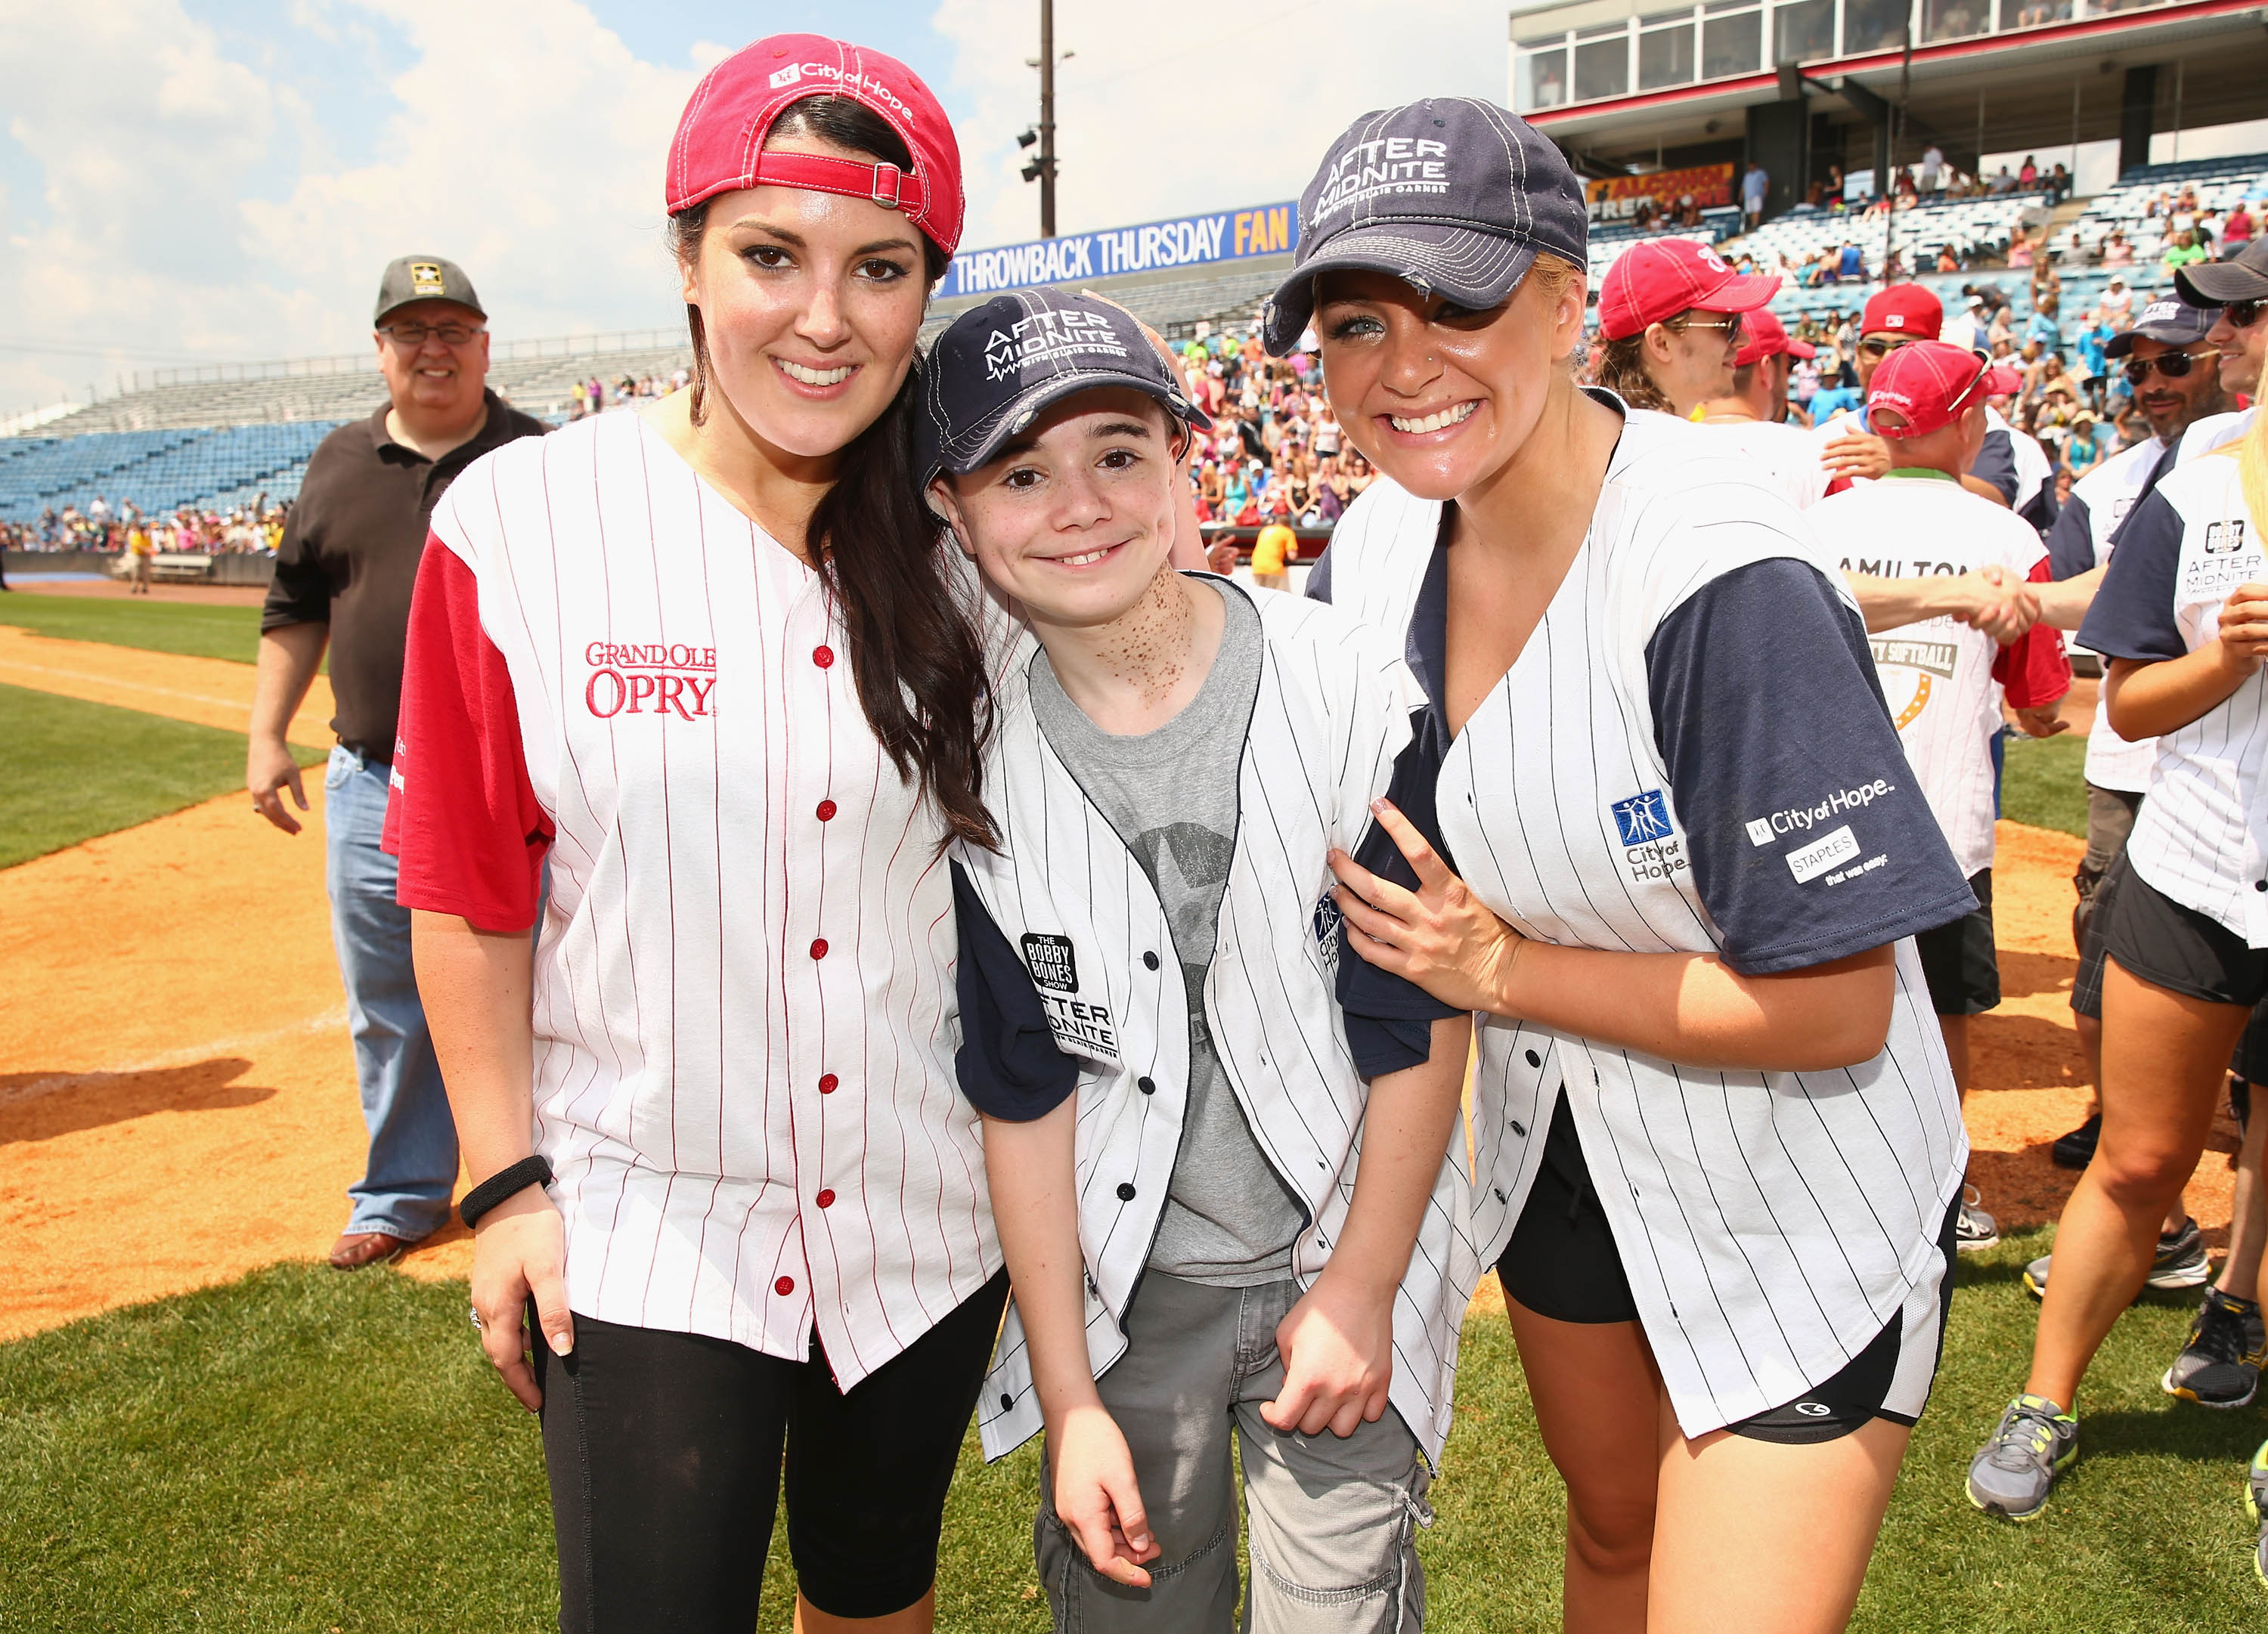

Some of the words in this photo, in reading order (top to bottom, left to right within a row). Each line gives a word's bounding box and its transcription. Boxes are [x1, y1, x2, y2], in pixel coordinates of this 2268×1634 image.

[801, 63, 842, 80] City
[844, 73, 861, 84] of
[863, 75, 914, 120] Hope
[1321, 138, 1447, 195] AFTER
[1314, 161, 1446, 210] MIDNITE
[1359, 187, 1391, 201] BLAIR
[1396, 185, 1446, 194] GARNER
[1613, 167, 1730, 199] ALCOHOL
[953, 237, 1092, 295] THROWBACK
[1098, 216, 1226, 274] THURSDAY
[1235, 207, 1289, 255] FAN
[984, 309, 1112, 352] AFTER
[985, 328, 1121, 371] MIDNITE
[1021, 355, 1050, 368] WITH
[1053, 347, 1085, 358] BLAIR
[1088, 346, 1128, 357] GARNER
[2188, 555, 2261, 574] AFTER
[2186, 570, 2260, 588] MIDNITE
[585, 642, 668, 667] GRAND
[669, 644, 717, 667] OLE
[1888, 642, 1952, 671] SOFTBALL
[585, 668, 717, 721] OPRY
[1771, 807, 1813, 834] City
[1814, 800, 1830, 820] of
[1828, 778, 1888, 814] Hope
[1626, 846, 1664, 865] City
[1665, 840, 1679, 856] of
[1792, 836, 1852, 873] STAPLES
[1631, 858, 1688, 882] Hope
[1825, 871, 1846, 887] that
[1845, 865, 1864, 879] was
[1027, 942, 1069, 965] BOBBY
[1037, 936, 1055, 945] THE
[1320, 930, 1338, 957] City
[1031, 961, 1073, 983] BONES
[1323, 952, 1338, 973] Ho
[1043, 979, 1067, 991] SHOW
[1040, 994, 1111, 1026] FTER
[1047, 1014, 1114, 1046] DNITE
